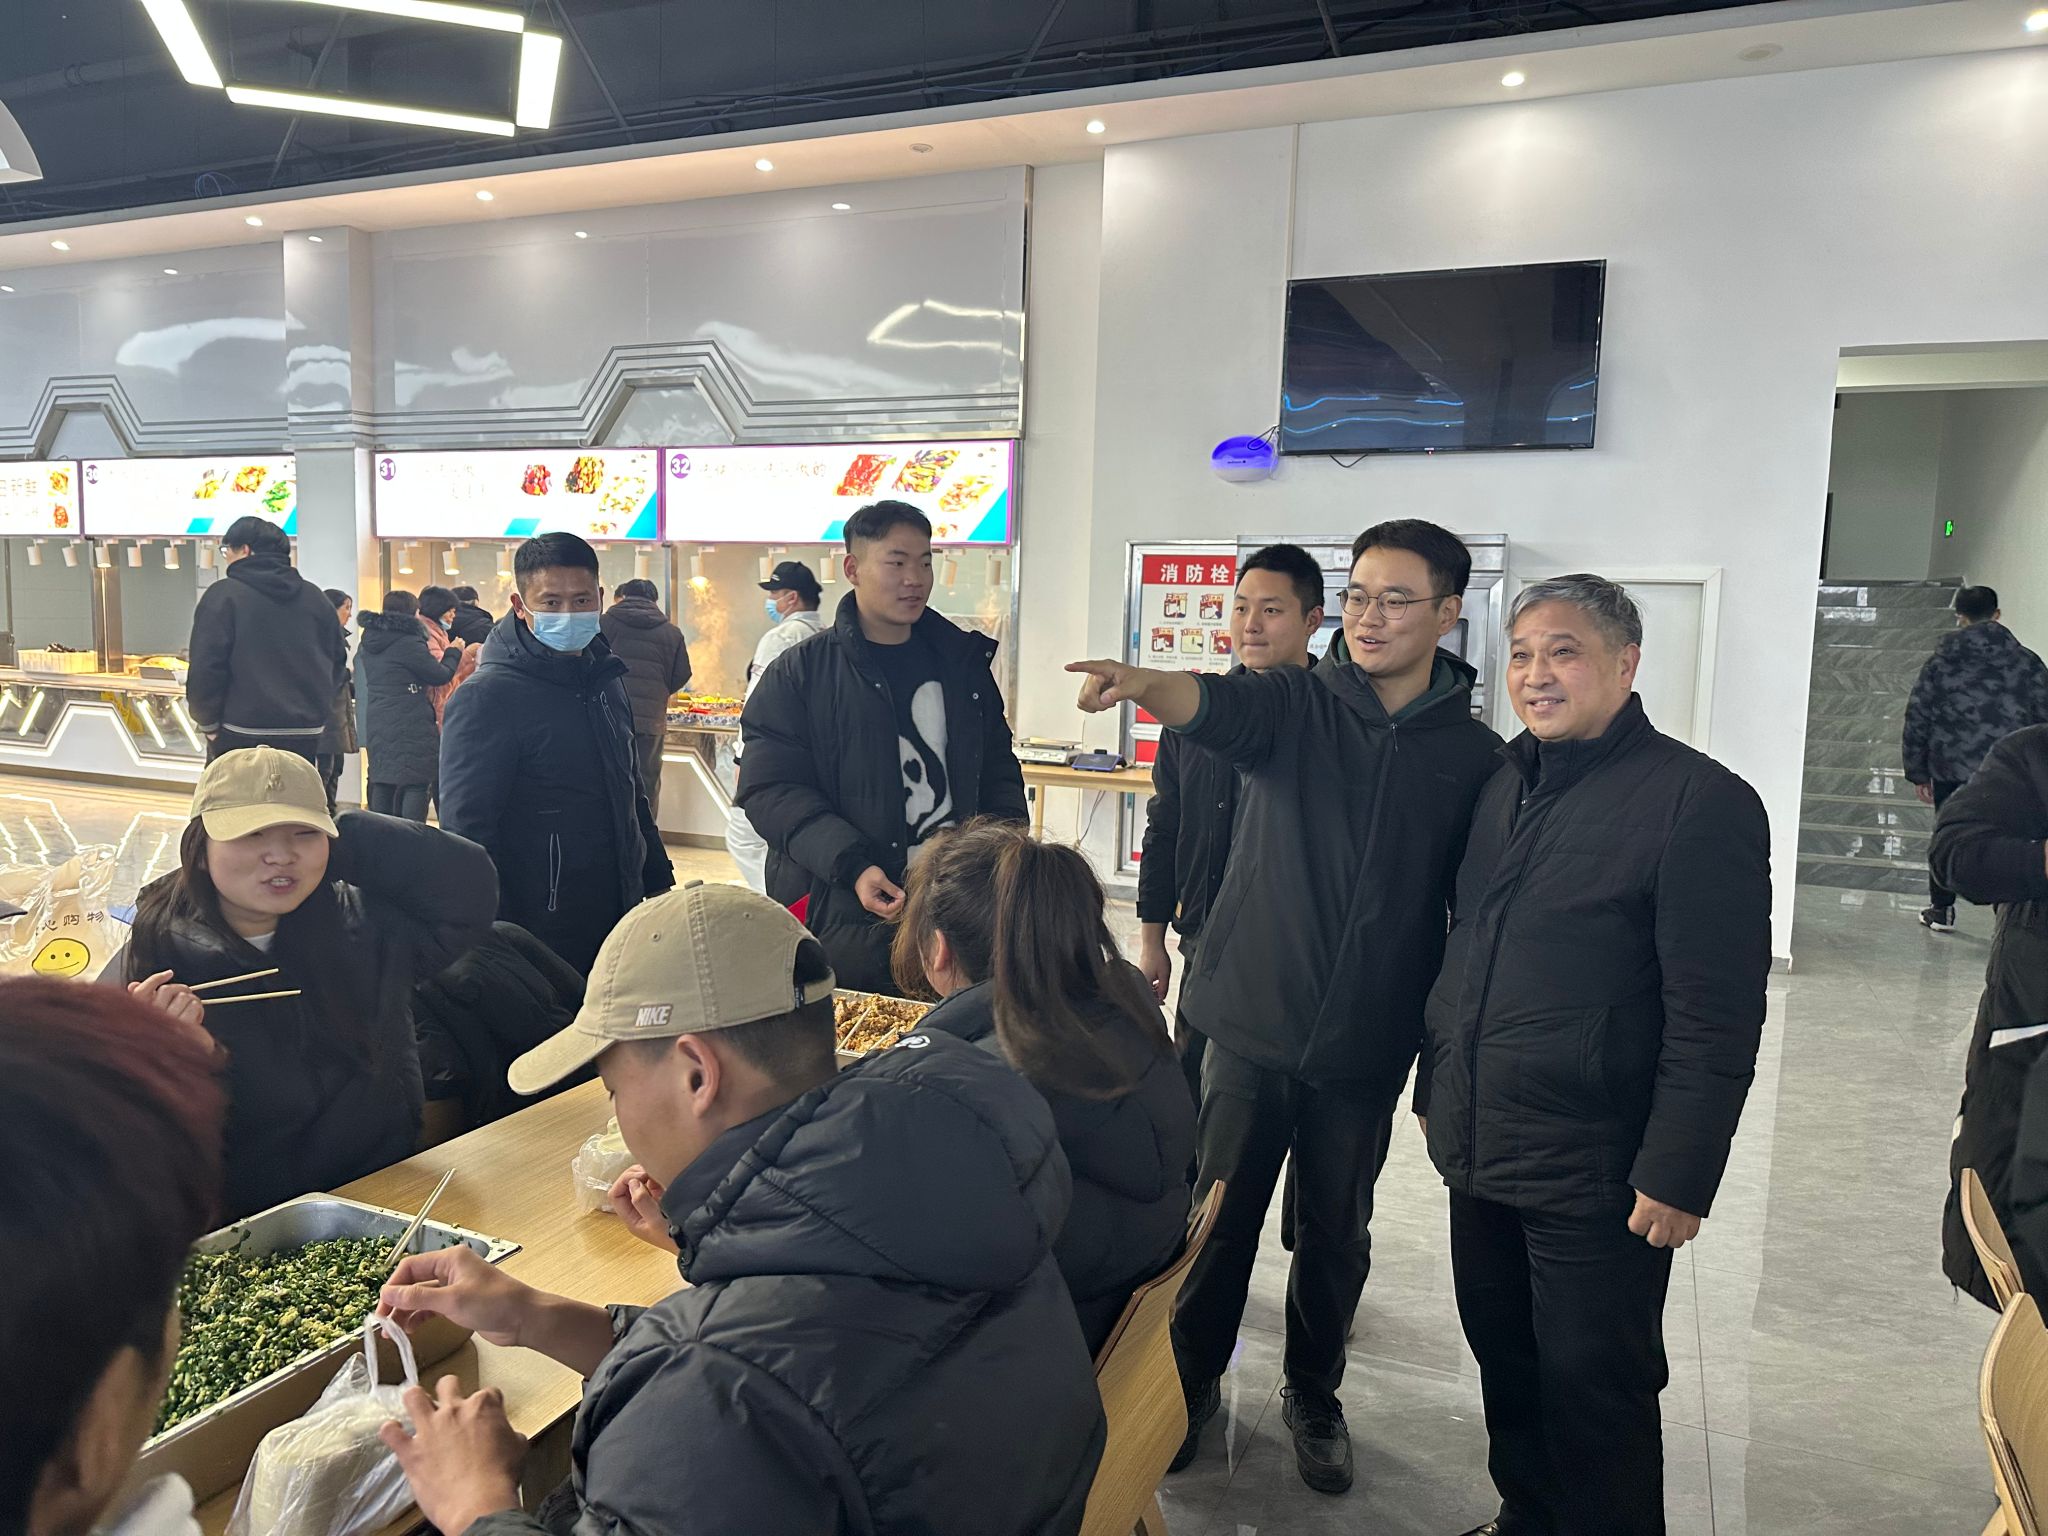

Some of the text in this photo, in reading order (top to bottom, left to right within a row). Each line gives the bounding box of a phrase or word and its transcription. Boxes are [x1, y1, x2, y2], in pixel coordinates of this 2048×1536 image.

[380, 461, 396, 478] 31
[671, 457, 691, 475] 32
[1160, 563, 1230, 584] 消防栓
[35, 910, 105, 937] 心购物
[635, 1005, 672, 1027] NIKE
